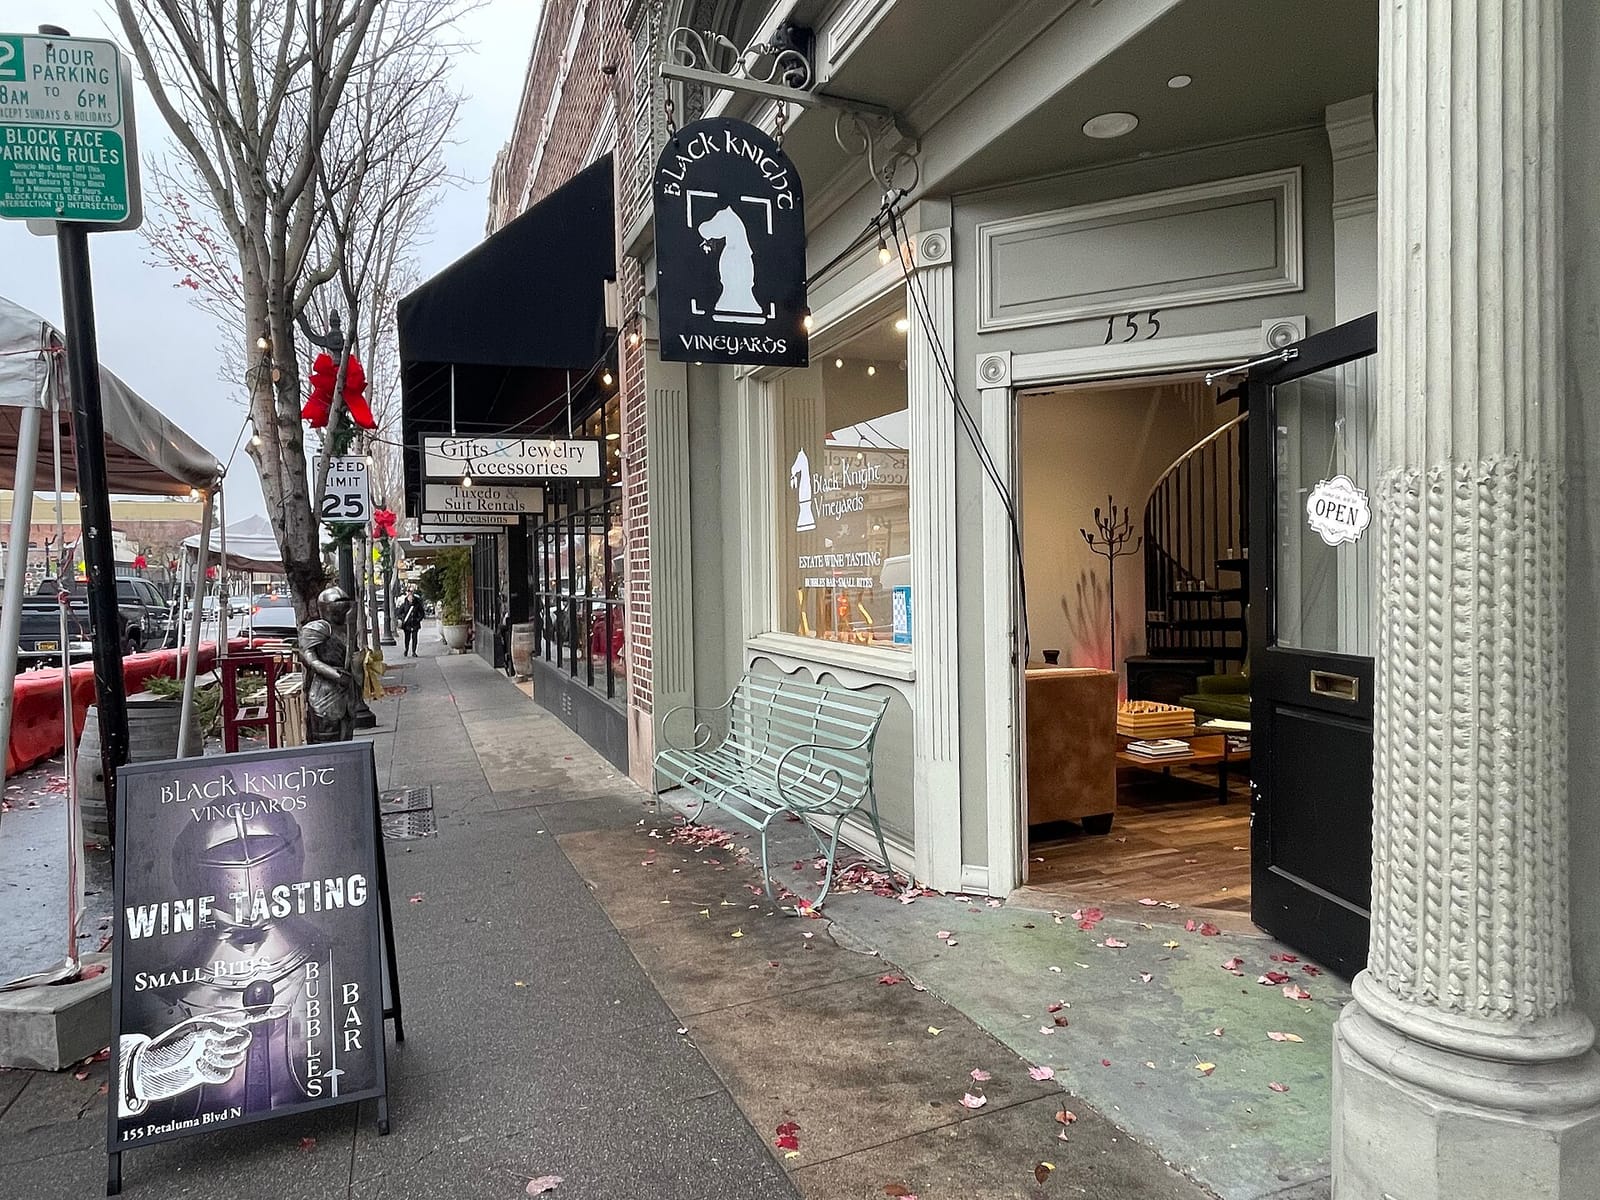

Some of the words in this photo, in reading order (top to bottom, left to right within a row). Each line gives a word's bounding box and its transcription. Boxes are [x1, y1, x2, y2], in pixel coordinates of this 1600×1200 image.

[46, 48, 94, 66] HOUR
[33, 64, 109, 84] PARKING
[0, 85, 29, 105] 8AM
[44, 86, 60, 97] TO
[78, 89, 107, 108] 6PM
[25, 109, 60, 120] SUNDAYS
[64, 111, 71, 120] &
[75, 111, 112, 123] HOLIDAYS
[6, 128, 58, 145] BLOCK
[64, 131, 104, 147] FACE
[68, 148, 119, 165] RULES
[663, 130, 720, 196] BLACK
[724, 130, 794, 210] KNIGHT
[0, 200, 51, 208] NTERSECTION
[55, 201, 65, 209] TO
[67, 202, 124, 211] INTERSECTION
[67, 194, 101, 202] DEFINED
[1105, 310, 1160, 344] 155
[679, 334, 787, 355] VINEYARDS
[440, 439, 488, 458] Gifts
[495, 440, 513, 457] &
[519, 441, 585, 463] Jewelry
[462, 459, 568, 475] Accessories
[813, 472, 841, 495] Black
[842, 458, 881, 490] Knight
[326, 477, 360, 487] IMIT
[451, 486, 501, 500] Tuxedo
[321, 494, 364, 517] 25
[444, 498, 472, 511] Suit
[477, 499, 525, 511] Rentals
[814, 491, 864, 520] Vineyards
[1316, 498, 1359, 526] OPEN
[433, 512, 449, 523] All
[455, 513, 508, 524] Occasions
[799, 556, 823, 568] ESTATE
[825, 554, 844, 568] WINE
[846, 552, 881, 567] TASTING
[160, 774, 237, 804] BLACK
[244, 766, 335, 793] KNIGHT
[191, 795, 307, 823] VINEYARDS
[126, 895, 217, 940] WINE
[229, 873, 367, 924] TASTING
[134, 968, 205, 992] SMALL
[342, 982, 362, 1052] BAR
[305, 961, 322, 1098] BUBBLES
[122, 1127, 144, 1142] 155
[147, 1118, 200, 1137] Petaluma
[202, 1109, 229, 1125] Blvd
[230, 1107, 242, 1118] N
